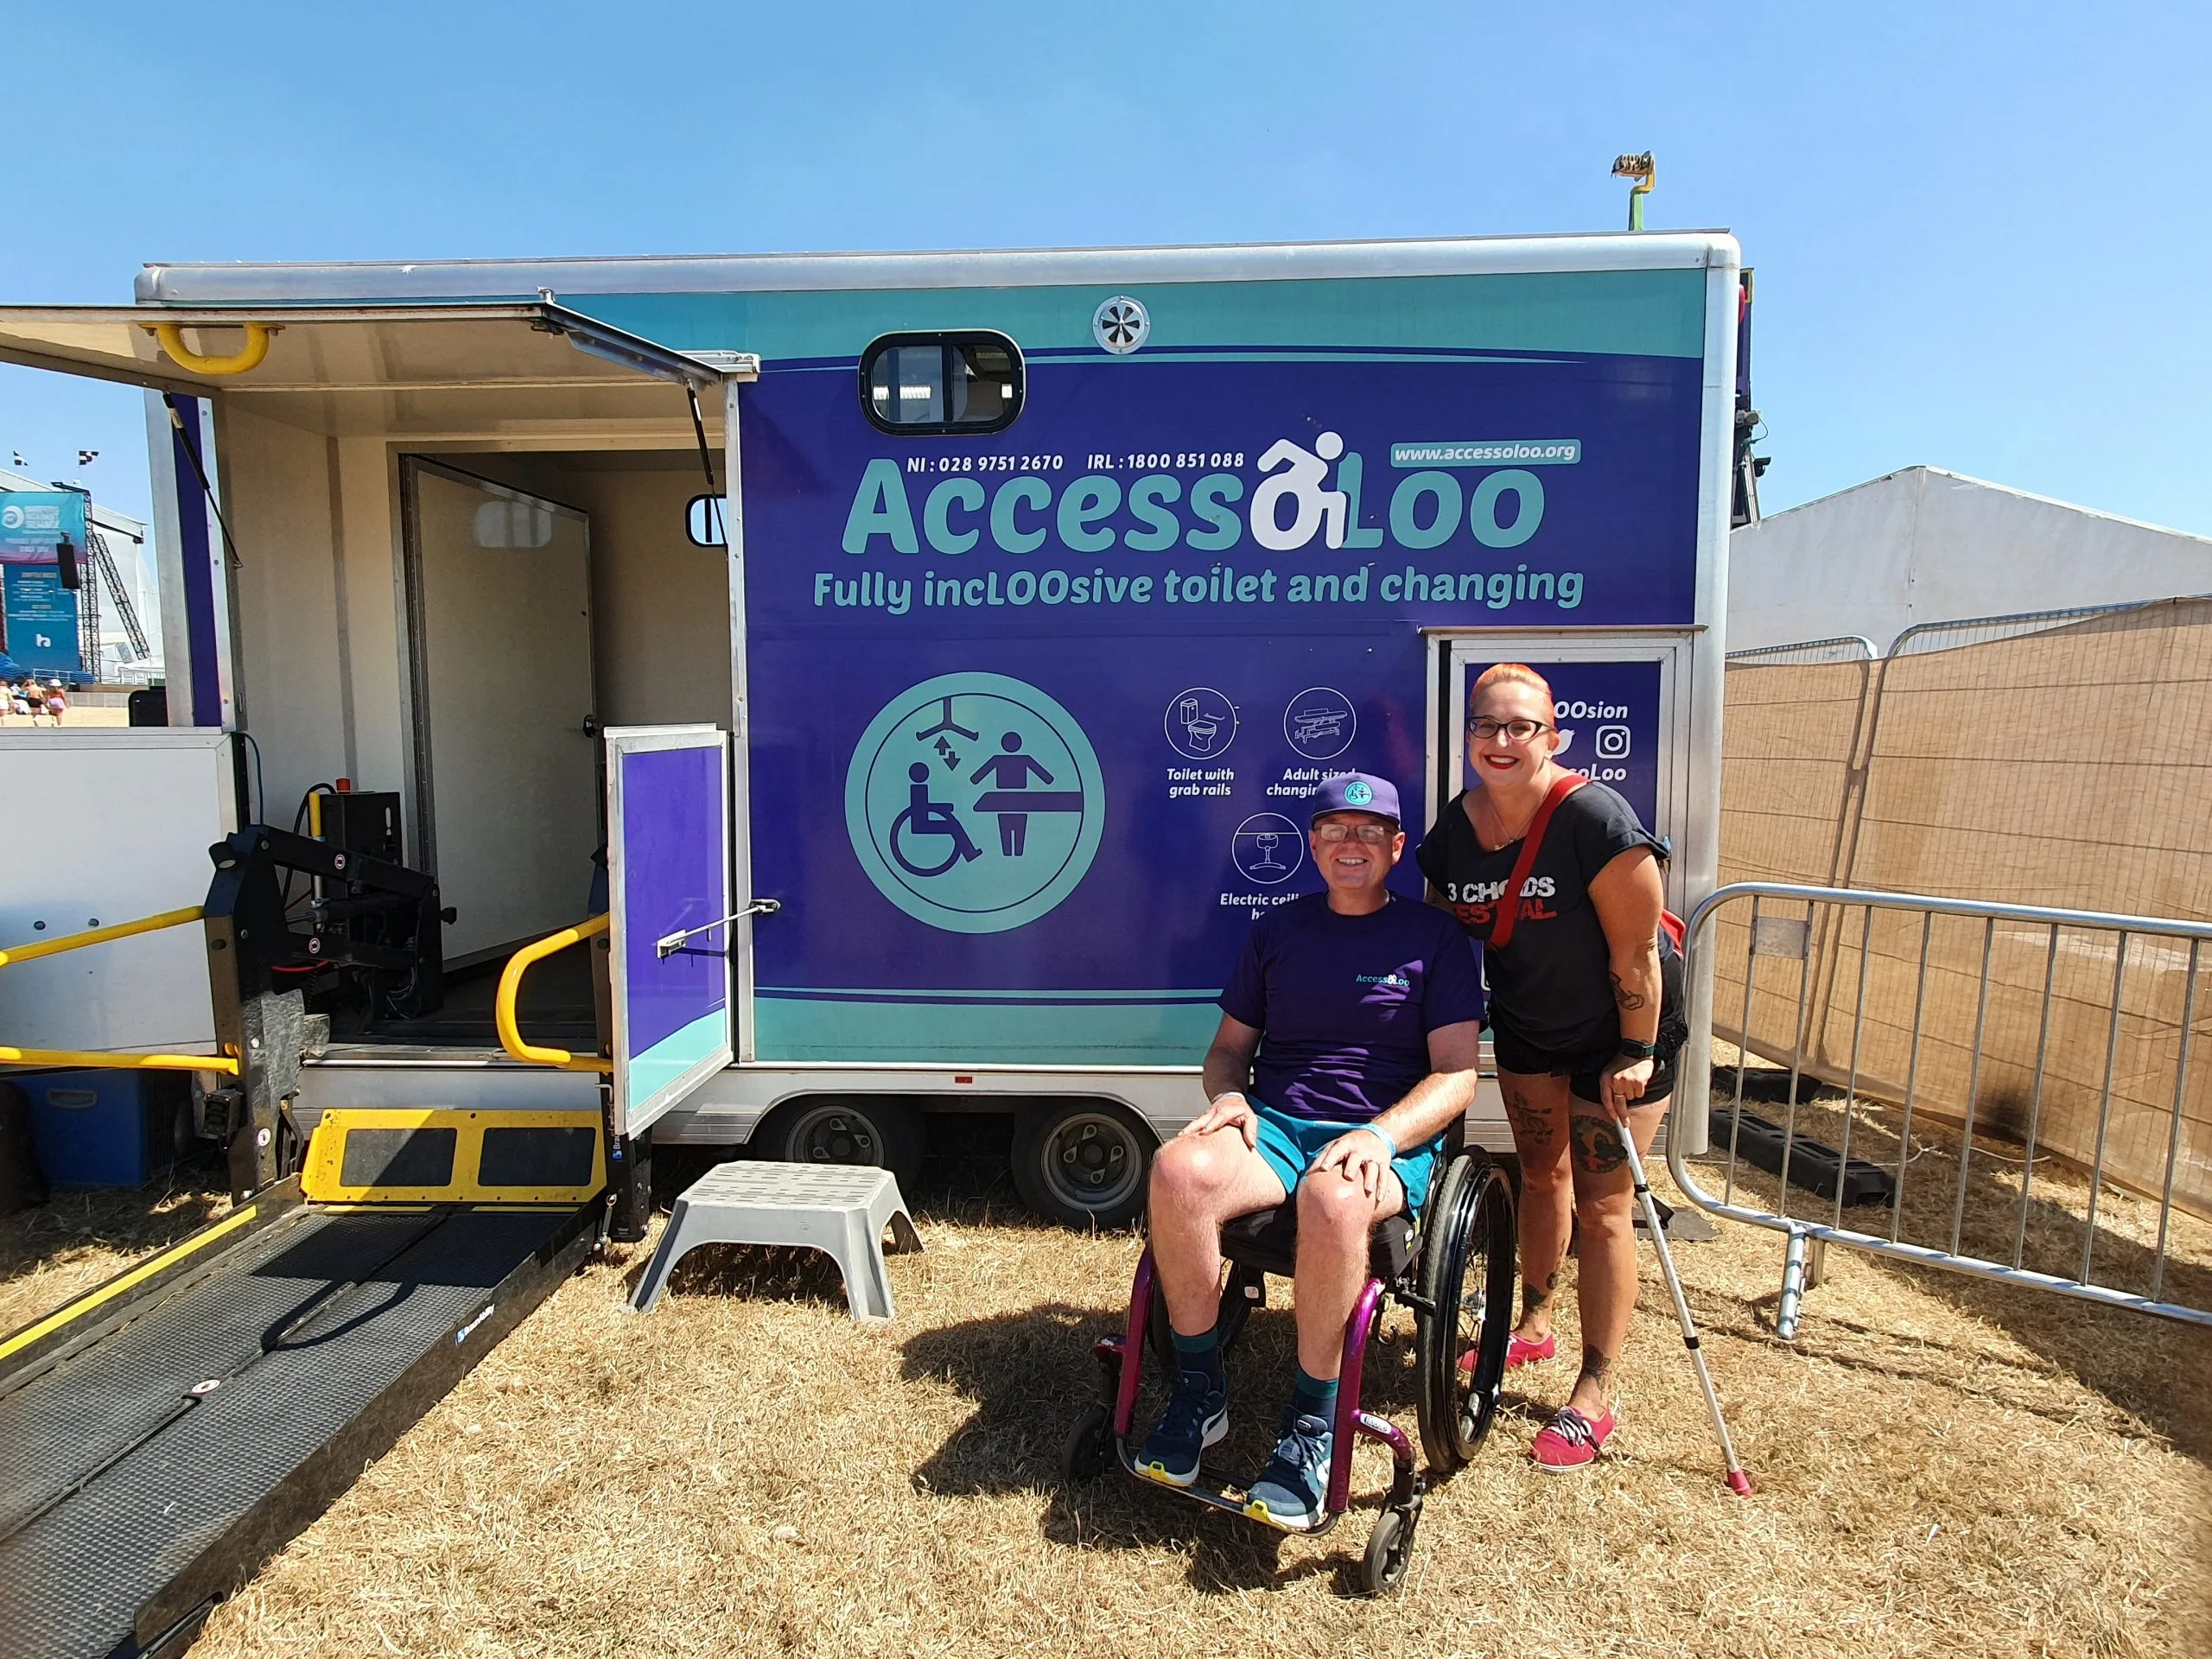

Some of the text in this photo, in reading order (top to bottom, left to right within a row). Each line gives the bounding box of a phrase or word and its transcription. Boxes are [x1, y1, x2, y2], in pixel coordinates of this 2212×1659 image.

[1394, 442, 1577, 461] www.accessoloo.org
[977, 455, 1015, 472] 9751
[1020, 454, 1064, 471] 2670
[1128, 453, 1171, 469] 1800
[1175, 452, 1206, 468] 851
[1210, 452, 1244, 467] 088
[813, 563, 1585, 615] Fully incLOOsive toilet and changing
[1554, 700, 1629, 719] OOsion
[1166, 767, 1235, 781] Toilet with
[1282, 767, 1356, 781] Adult siz
[1169, 783, 1231, 798] grab rails
[1266, 782, 1318, 799] changi
[1447, 876, 1556, 903] 3 CHDS
[1220, 893, 1269, 906] Electric
